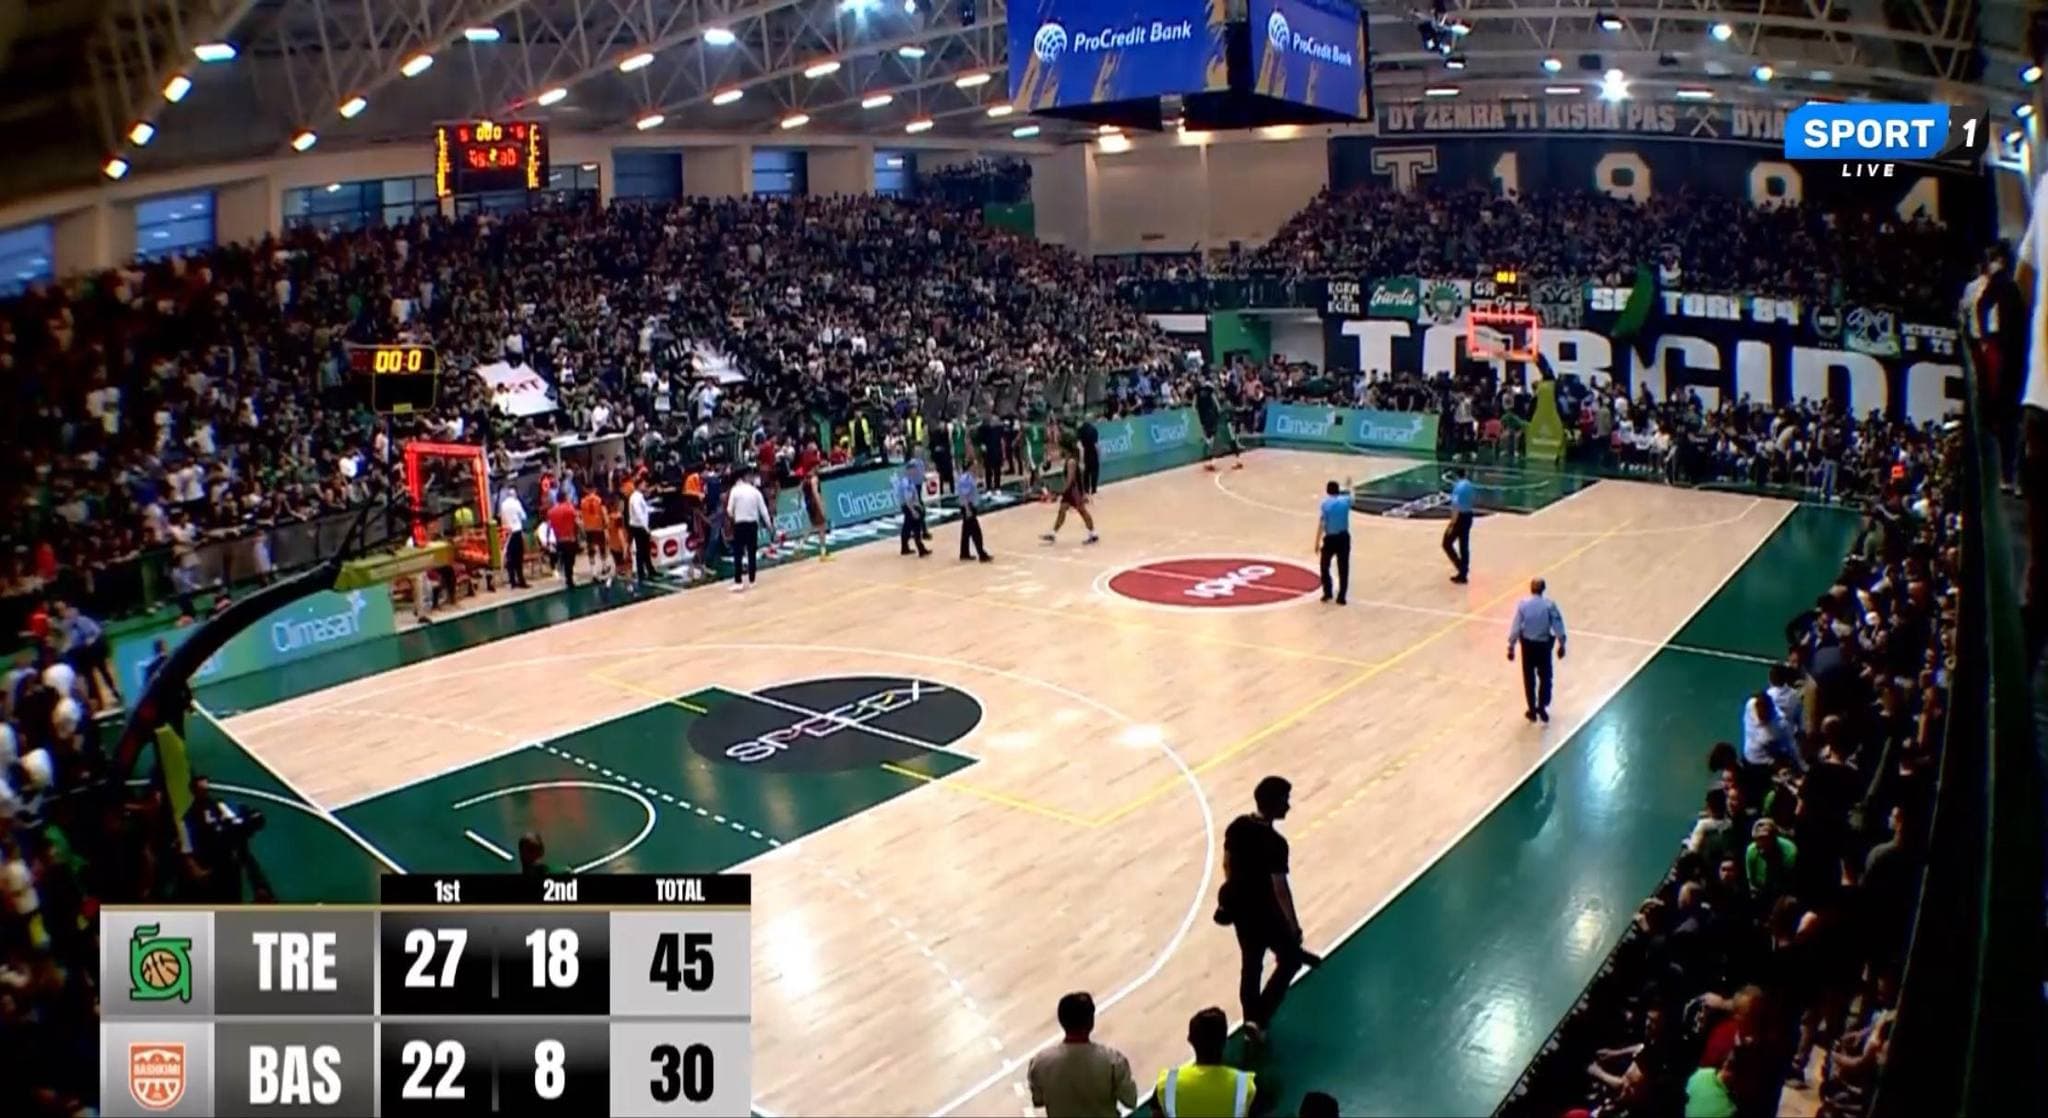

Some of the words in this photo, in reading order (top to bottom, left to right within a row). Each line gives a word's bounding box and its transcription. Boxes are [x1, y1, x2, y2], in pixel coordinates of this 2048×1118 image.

[1074, 26, 1146, 53] ProCredit
[1150, 20, 1192, 43] Bank
[1293, 32, 1331, 60] ProCredit
[1332, 45, 1351, 66] Bank
[1388, 104, 1415, 130] DY
[1424, 103, 1505, 129] ZEMRA
[1511, 102, 1538, 128] TI
[1545, 103, 1620, 129] KISHA
[1627, 104, 1676, 131] PAS
[271, 610, 359, 652] Climasan
